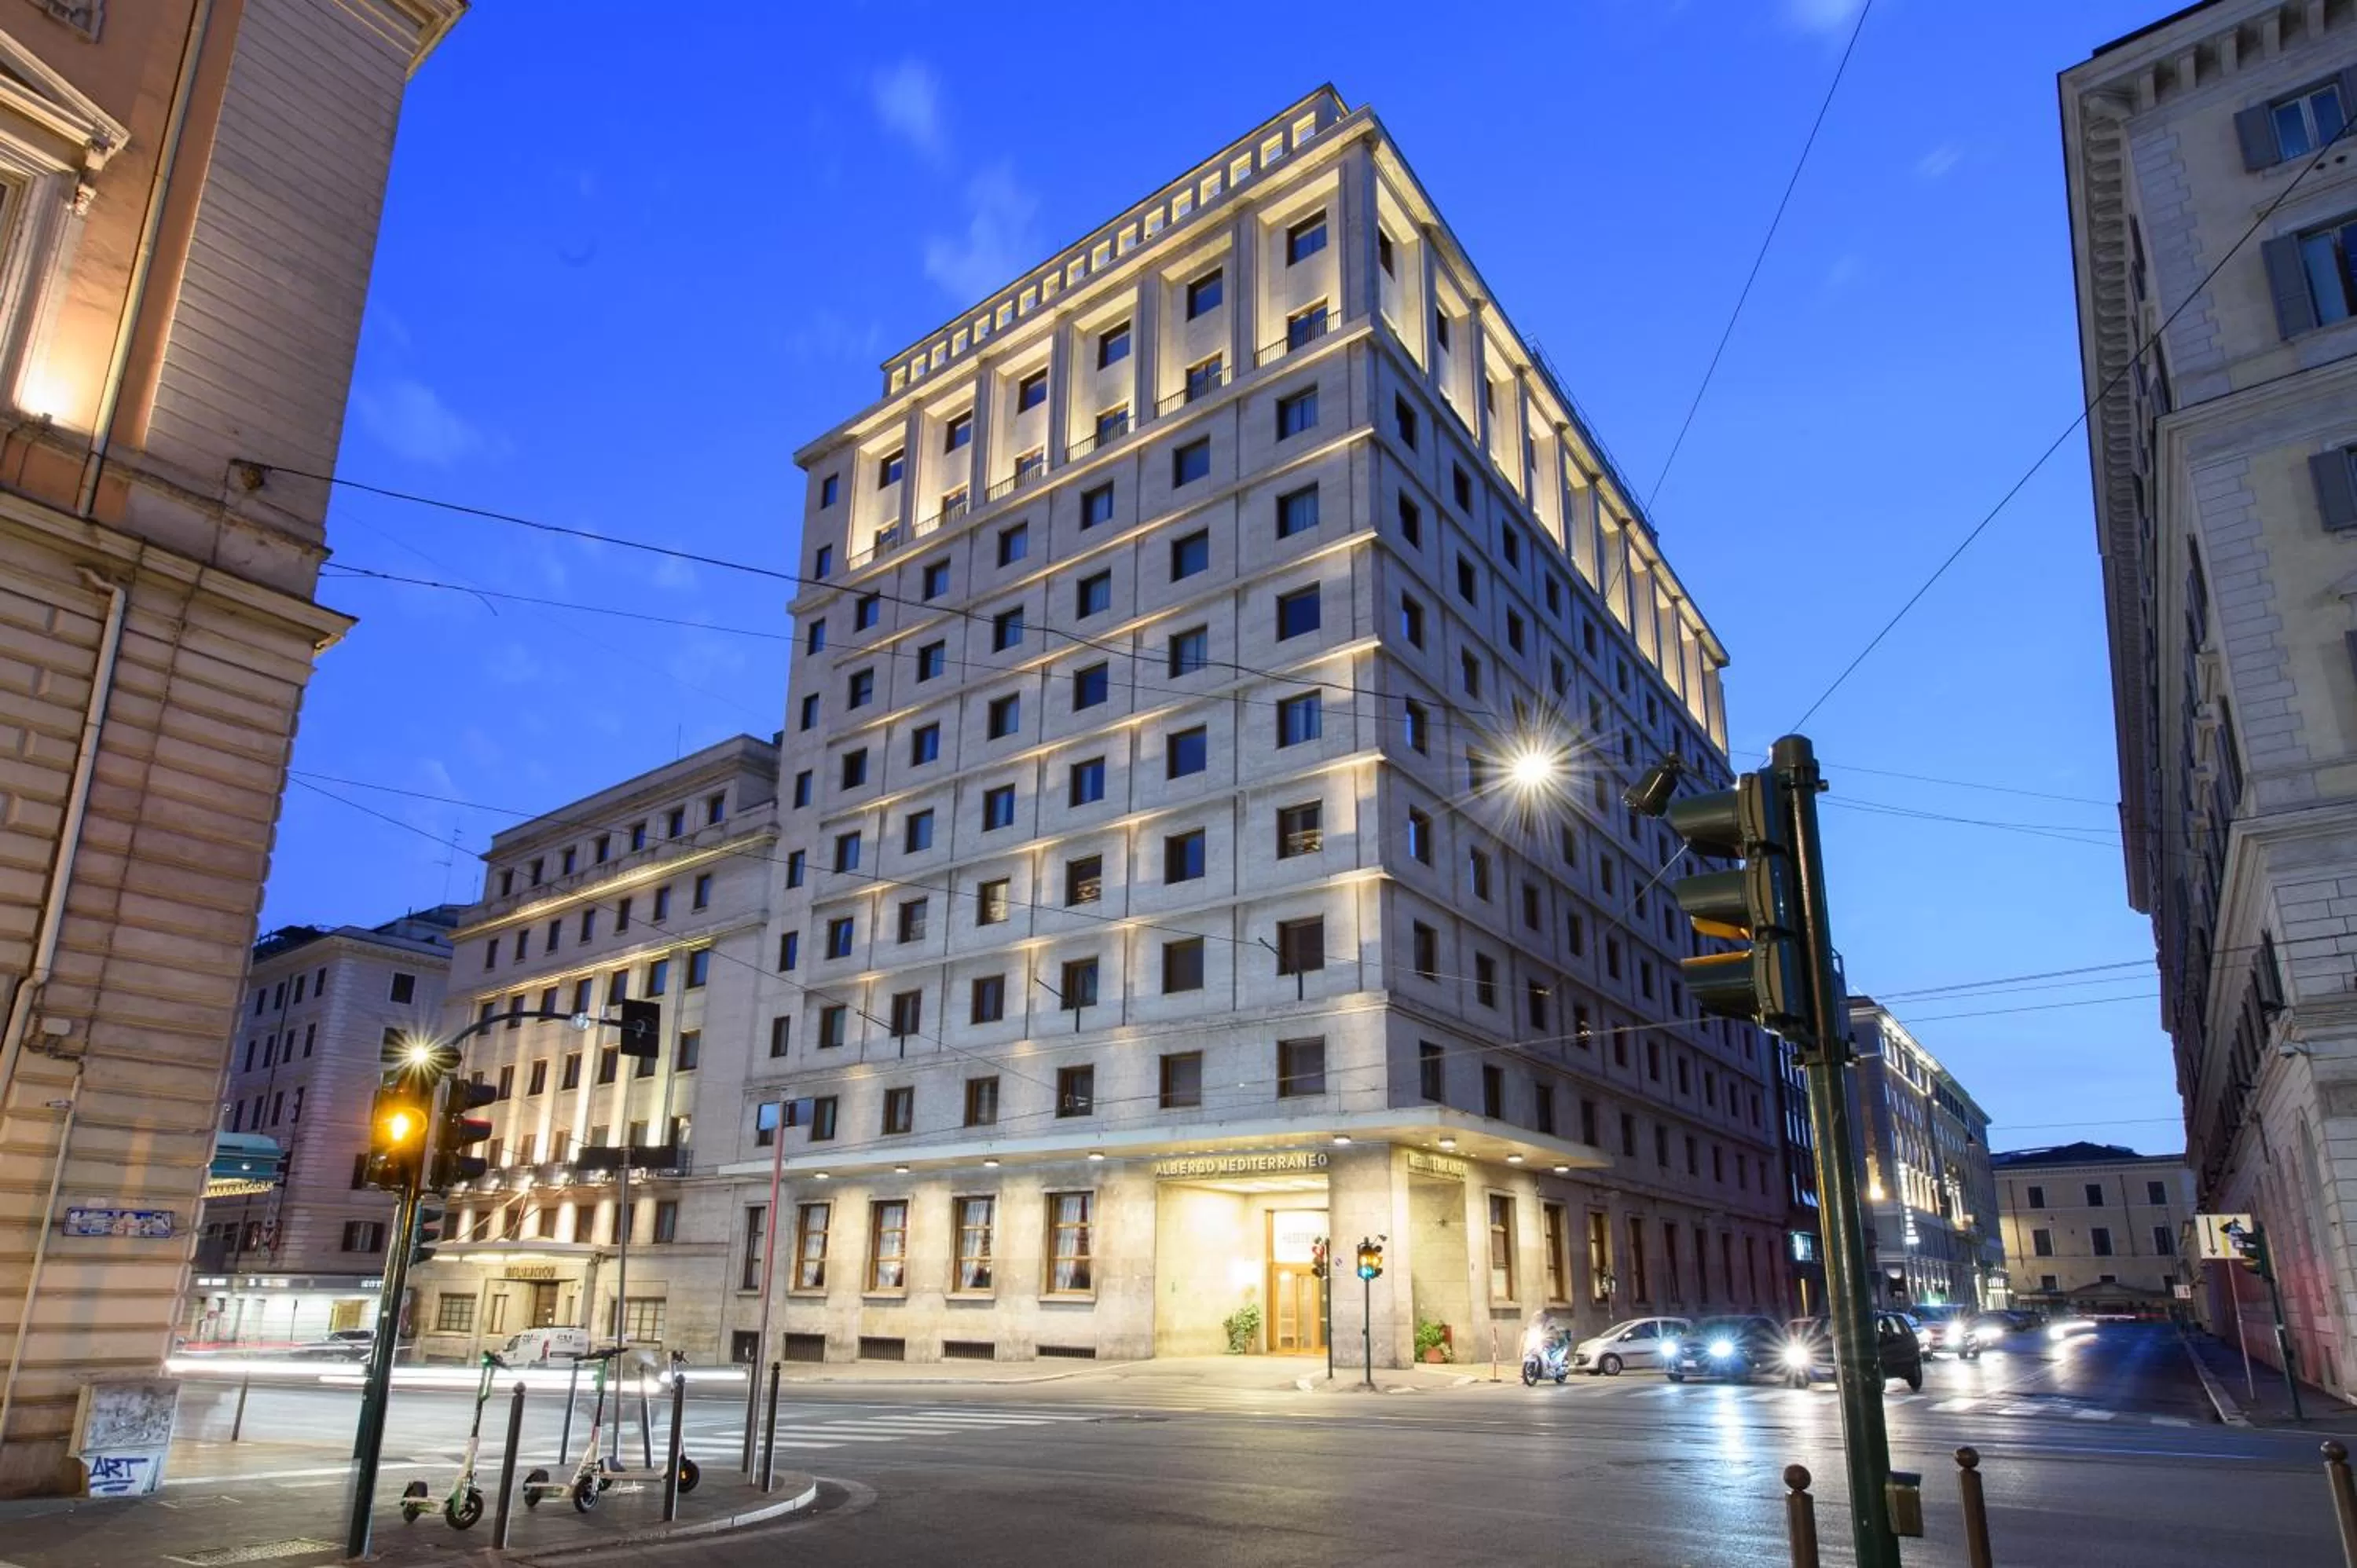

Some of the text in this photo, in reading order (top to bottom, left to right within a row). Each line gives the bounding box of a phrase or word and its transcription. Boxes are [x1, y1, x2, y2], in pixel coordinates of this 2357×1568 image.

[1156, 1153, 1328, 1175] ALBERGO MEDITERRANEO
[88, 1455, 148, 1478] ART
